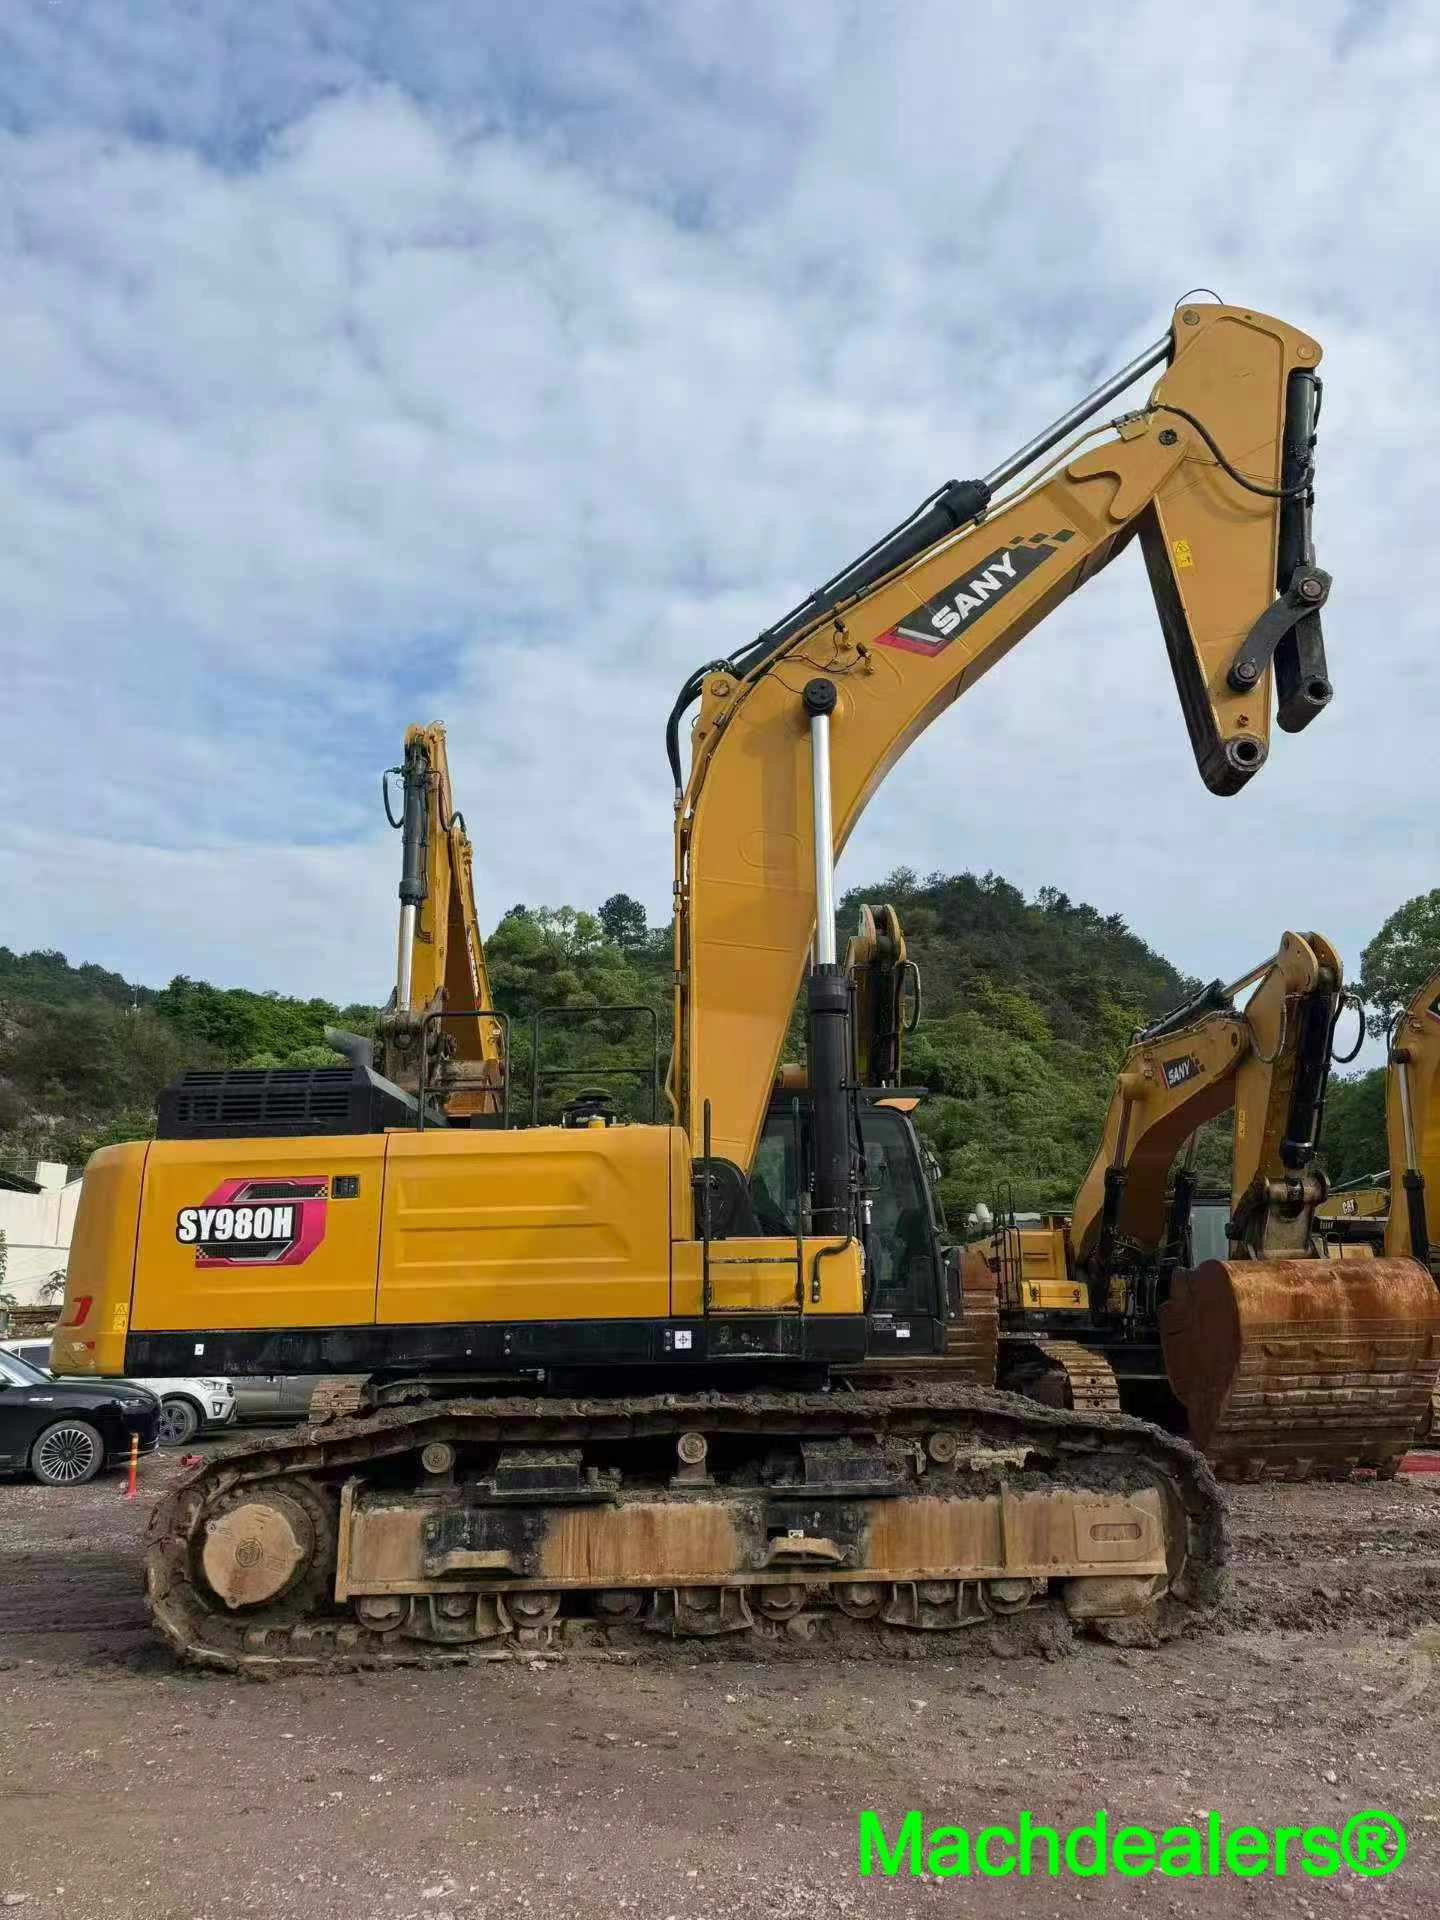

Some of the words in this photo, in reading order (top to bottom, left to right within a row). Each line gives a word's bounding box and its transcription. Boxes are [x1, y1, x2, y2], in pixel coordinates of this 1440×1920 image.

[931, 551, 1018, 636] SANY
[1168, 1058, 1190, 1085] SANY
[178, 1206, 294, 1242] SY980H
